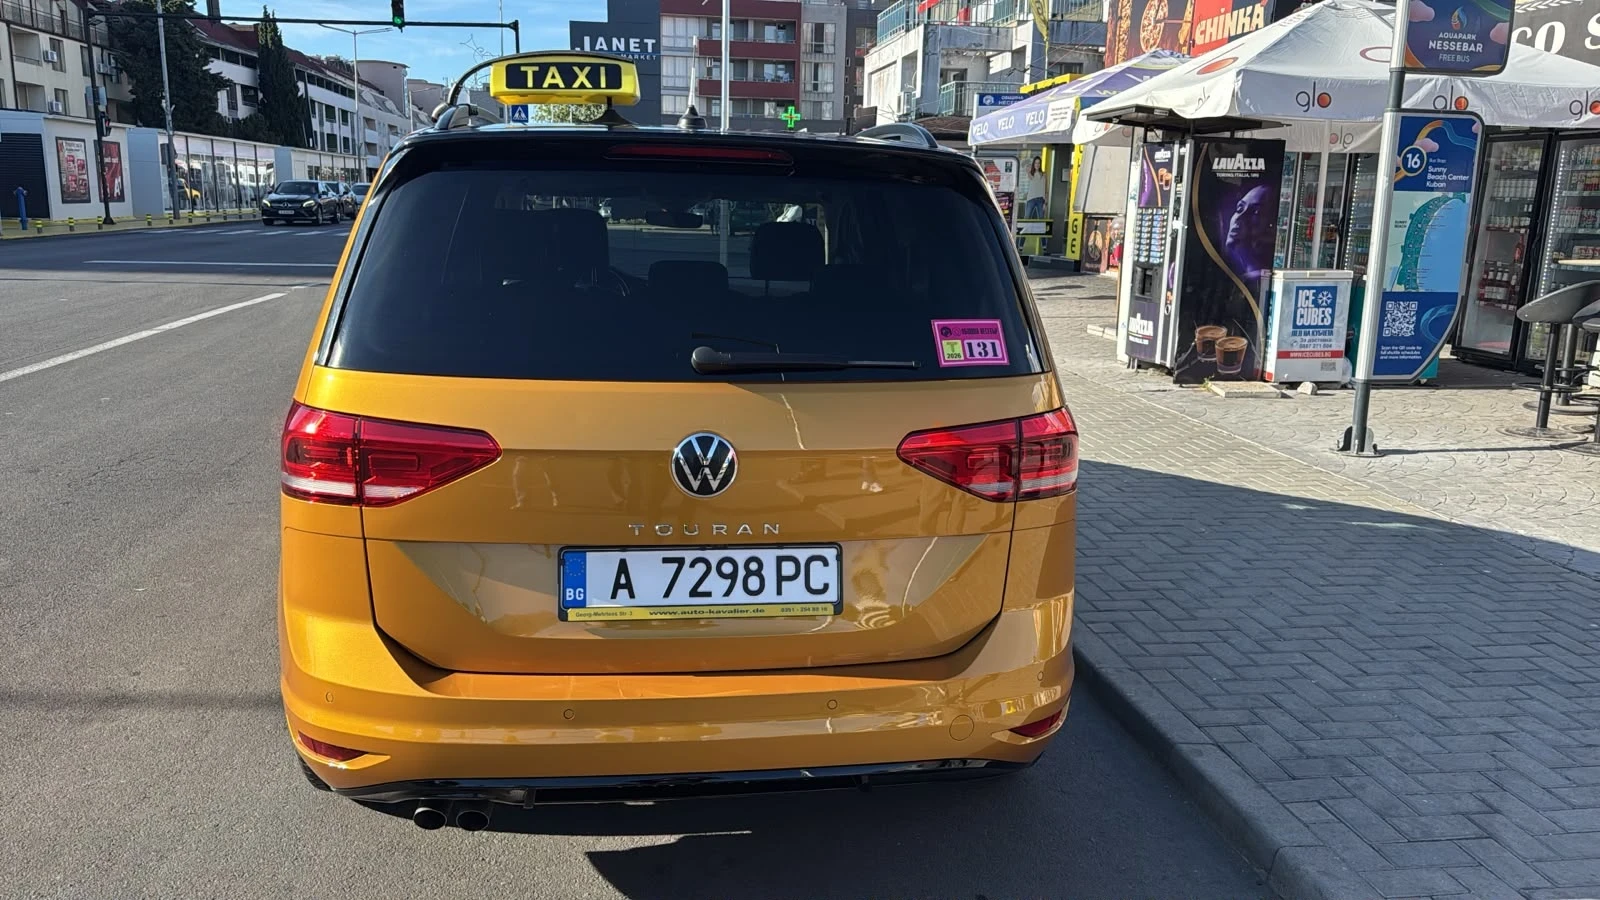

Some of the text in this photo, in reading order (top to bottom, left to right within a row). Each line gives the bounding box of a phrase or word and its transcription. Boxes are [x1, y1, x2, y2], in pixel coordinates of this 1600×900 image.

[1438, 32, 1476, 41] AQUAPARK
[575, 36, 656, 53] JANET
[1429, 40, 1483, 52] NESSEBAR
[1438, 53, 1470, 63] FREE BUS
[520, 66, 607, 89] TAXI
[1296, 81, 1332, 113] glo
[998, 116, 1015, 130] VELO
[1025, 110, 1045, 125] VELO
[972, 122, 989, 136] VELO
[1212, 153, 1266, 170] LAVAZZA
[1406, 153, 1421, 169] 16
[1428, 166, 1447, 174] Sunny
[1297, 289, 1317, 308] ICE
[1295, 307, 1332, 326] CUBES
[966, 341, 999, 358] 131
[628, 524, 780, 536] TOURAN
[610, 554, 829, 599] A 7298 PC
[565, 588, 584, 600] BG
[649, 608, 766, 616] www.auto-kavalier.de
